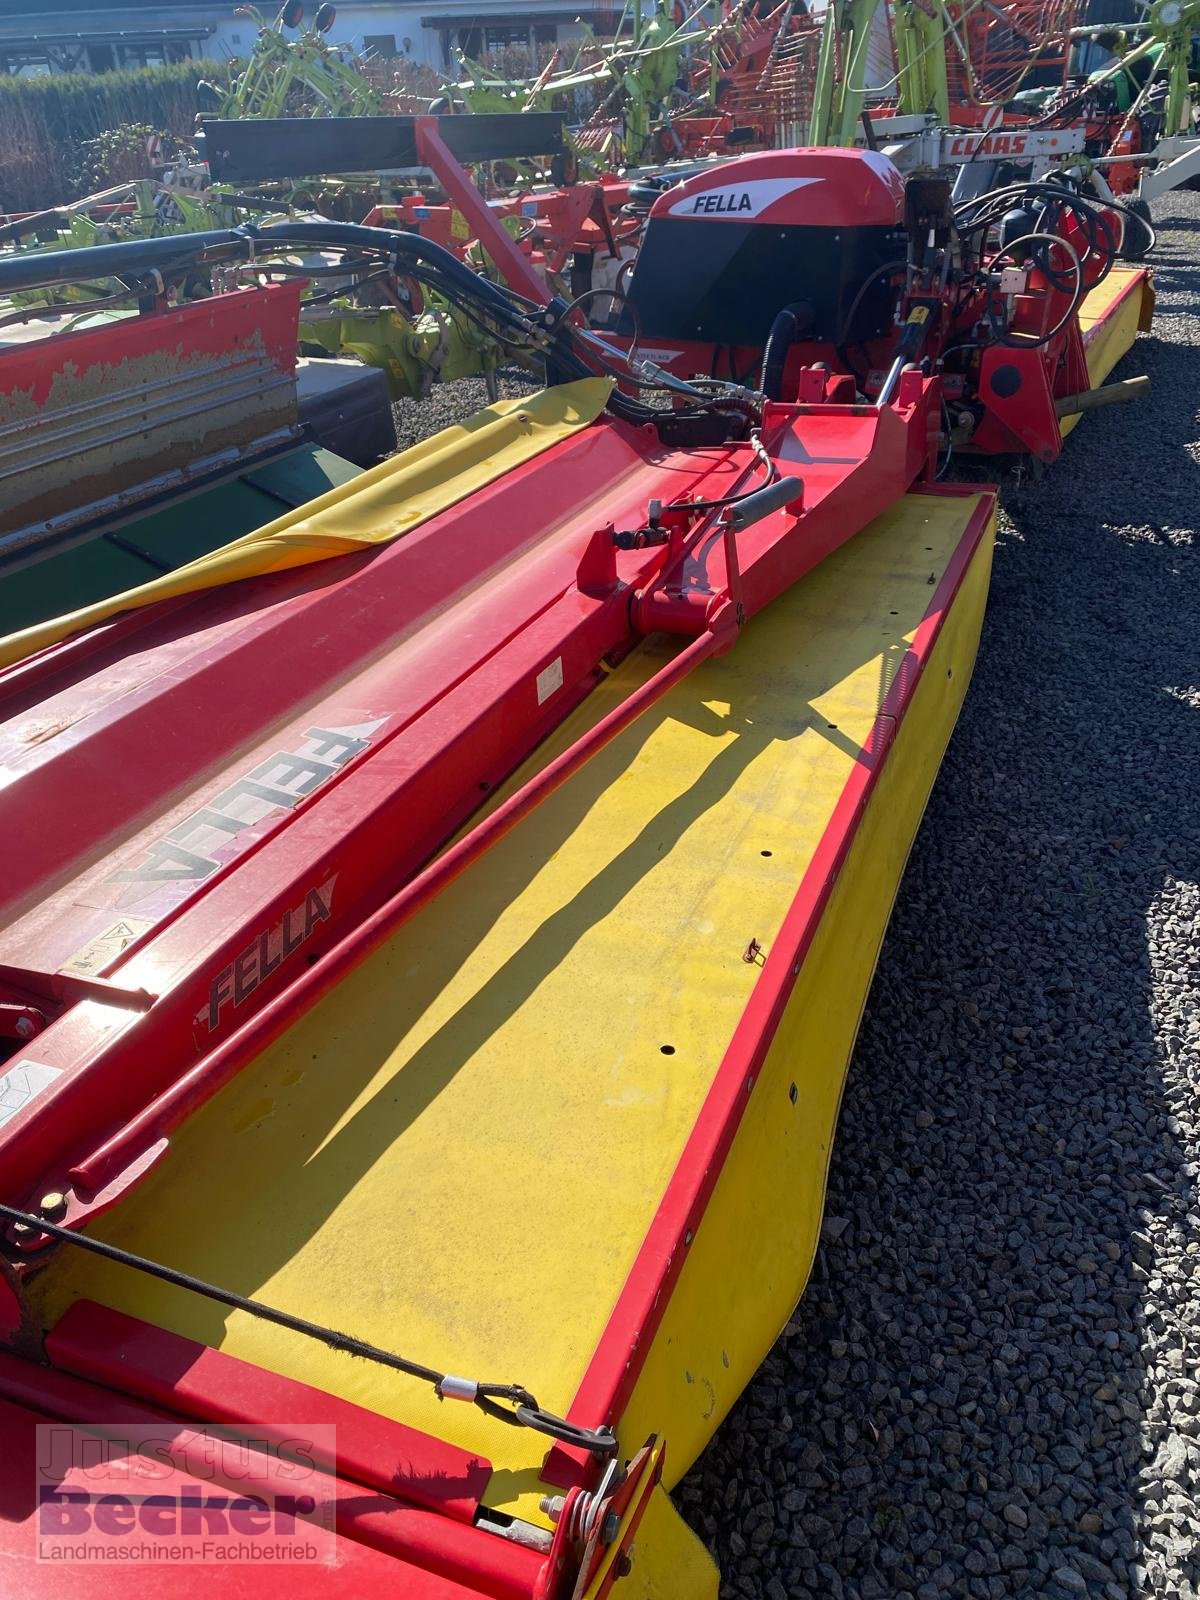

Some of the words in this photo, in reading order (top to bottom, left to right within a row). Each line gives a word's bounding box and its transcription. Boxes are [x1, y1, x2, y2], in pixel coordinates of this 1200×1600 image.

[950, 135, 1028, 156] CLAAS
[693, 193, 752, 213] FELLA
[102, 726, 372, 884] FELLA
[208, 886, 331, 1032] FELLA
